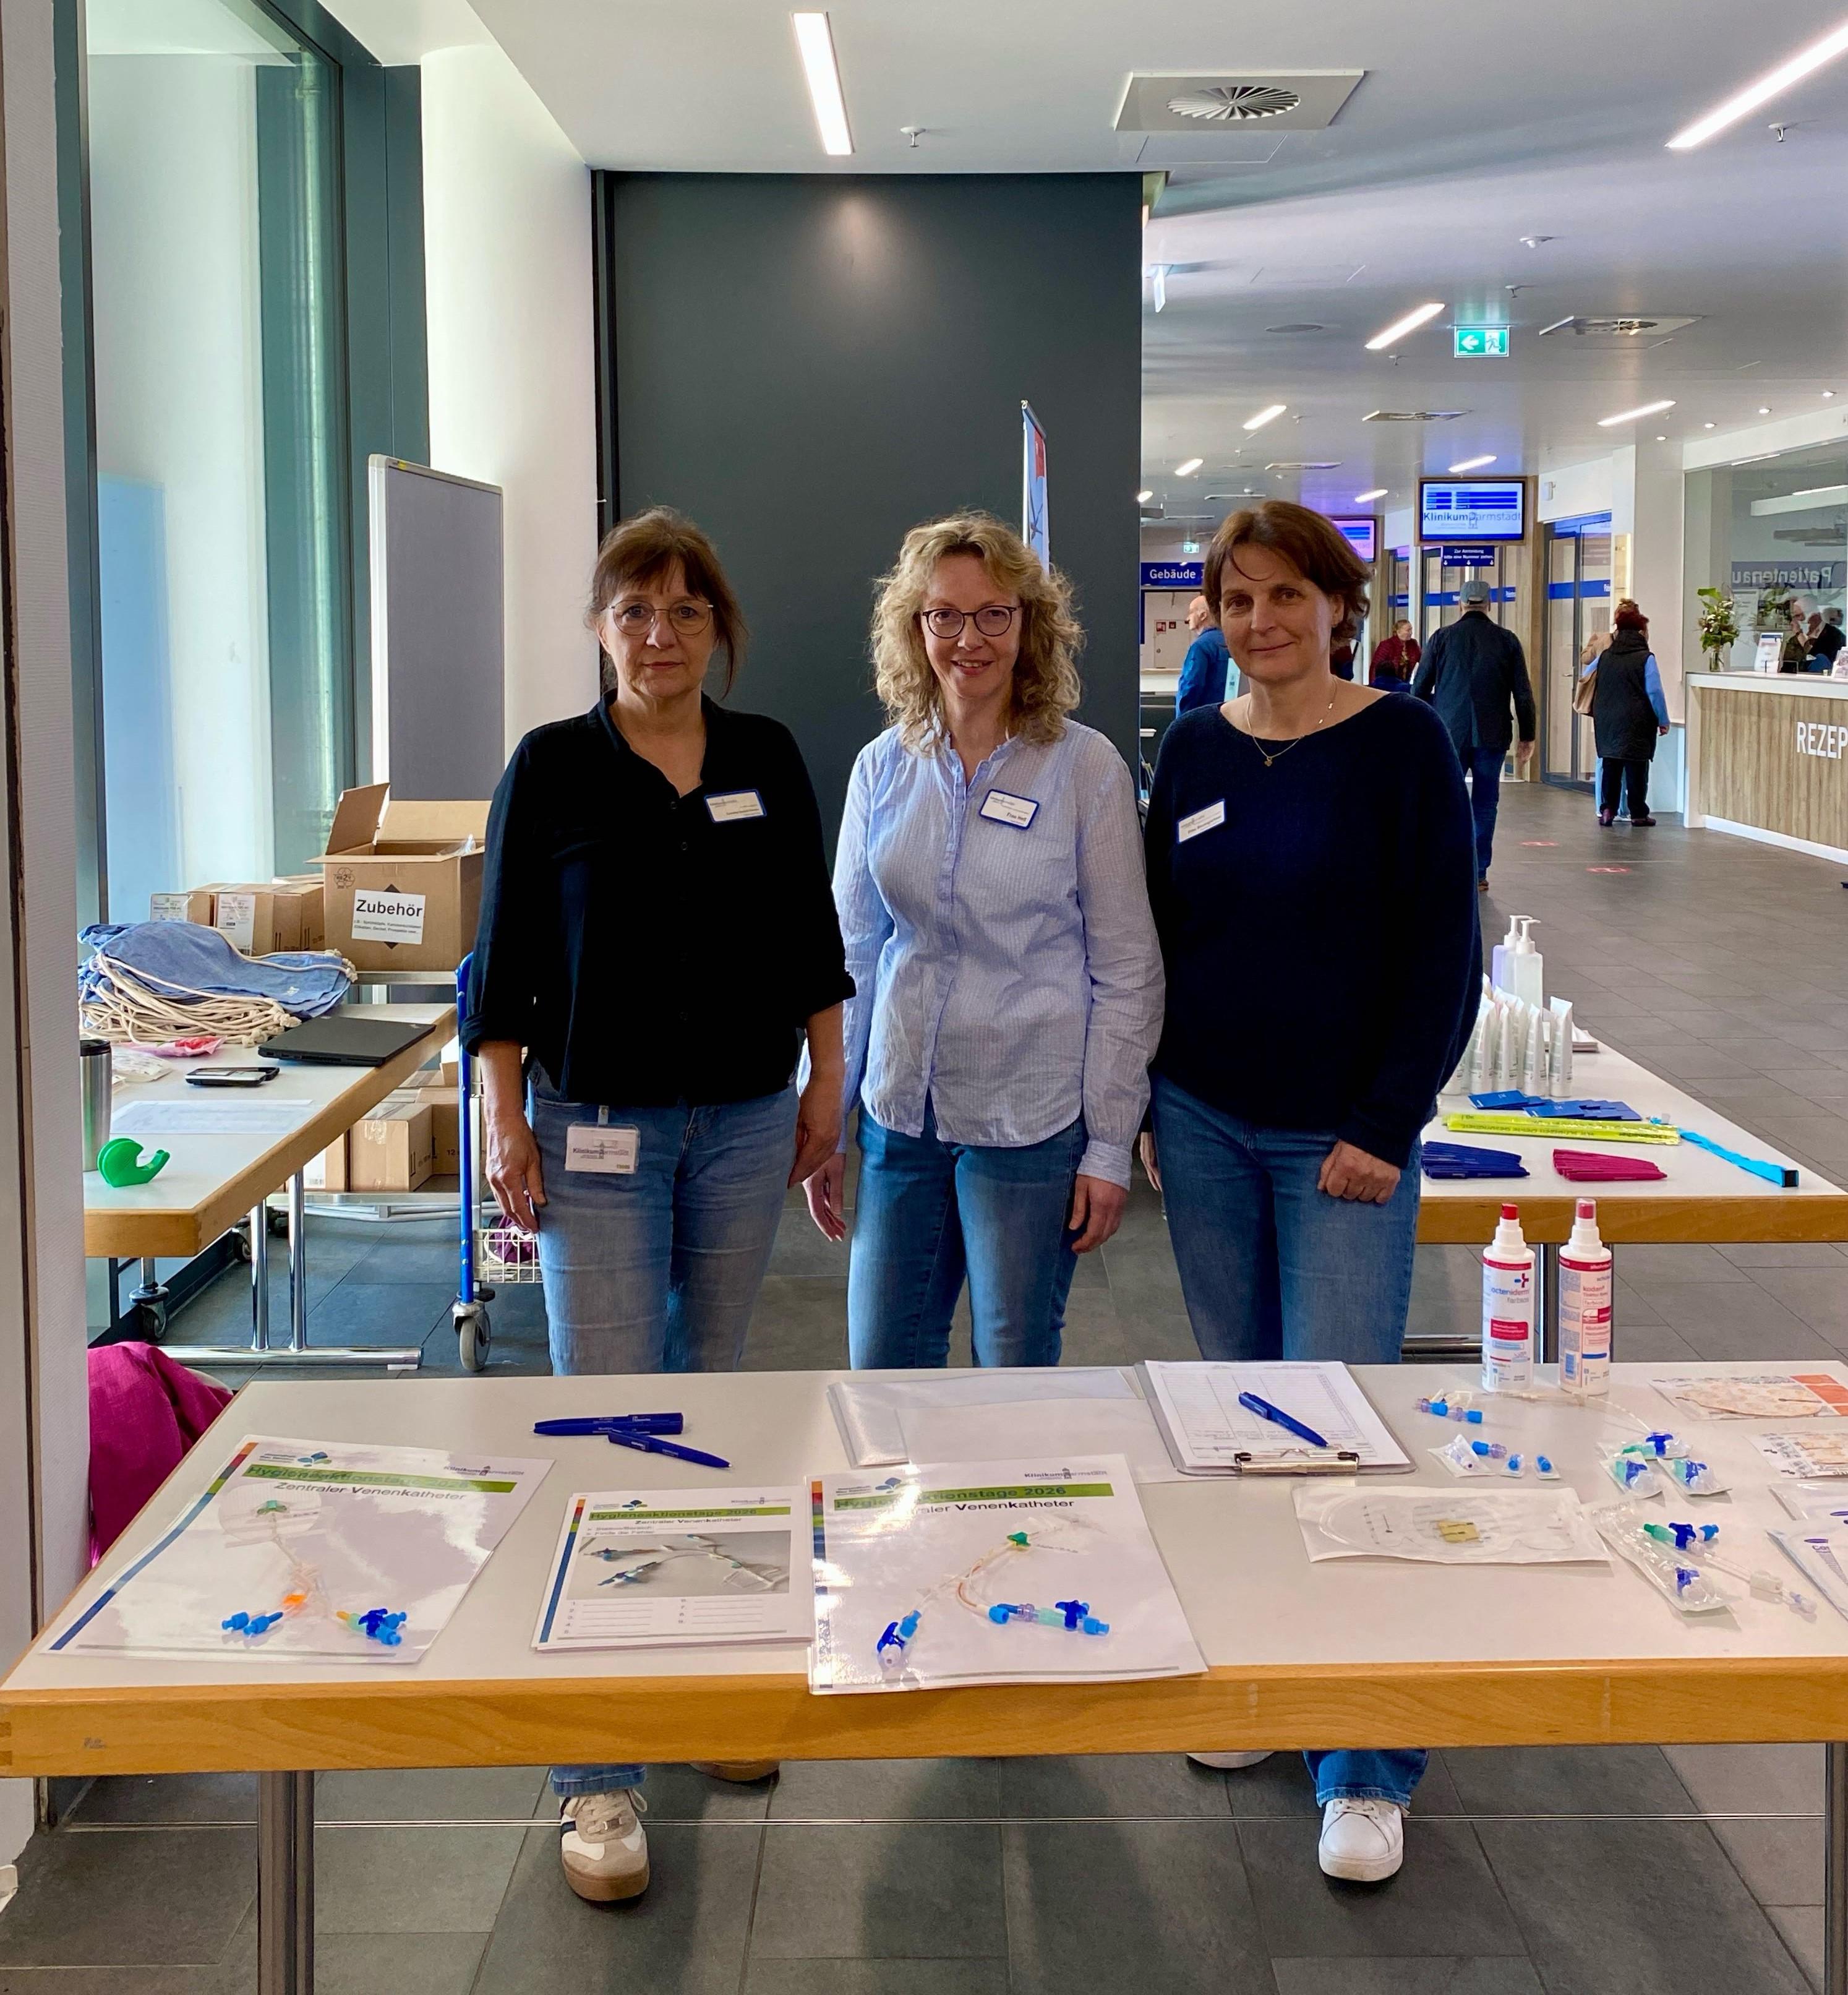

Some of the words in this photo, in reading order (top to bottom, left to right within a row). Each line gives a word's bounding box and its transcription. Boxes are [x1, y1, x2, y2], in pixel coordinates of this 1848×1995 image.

[1149, 568, 1197, 579] Gebäude
[1796, 721, 1848, 760] REZEP
[356, 898, 424, 917] Zubehör
[274, 1482, 346, 1493] Zentraler
[351, 1486, 467, 1501] Venenkatheter
[1024, 1487, 1067, 1496] 2026
[954, 1500, 1075, 1511] Venenkatheter
